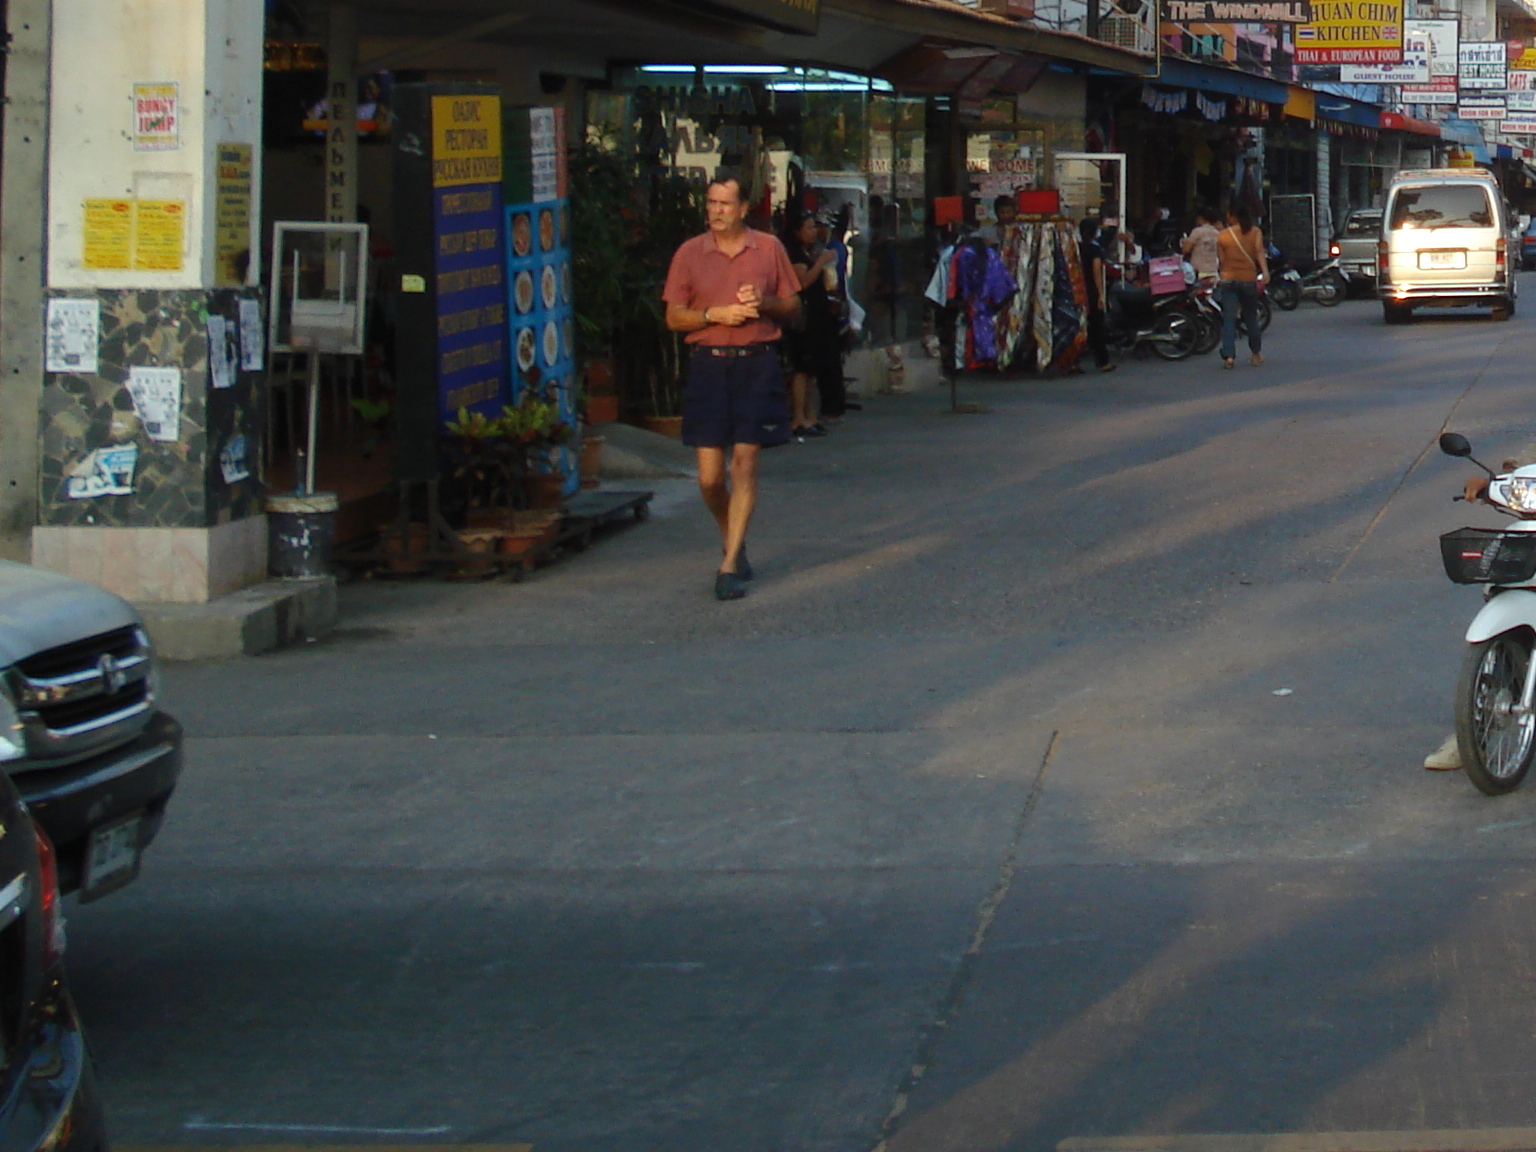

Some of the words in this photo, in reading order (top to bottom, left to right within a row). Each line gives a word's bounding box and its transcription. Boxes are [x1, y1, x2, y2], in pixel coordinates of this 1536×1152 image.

[1167, 0, 1205, 20] THE
[1211, 0, 1307, 22] WINDMILL
[1310, 2, 1353, 22] HUAN
[1357, 1, 1399, 23] CHIM
[1316, 25, 1381, 42] KITCHEN
[1298, 50, 1320, 62] THAI
[1322, 53, 1328, 61] &
[1331, 50, 1376, 62] EUROPEAN
[1378, 49, 1400, 62] FOOD
[1460, 64, 1478, 78] UEST
[634, 84, 758, 115] SHISHA
